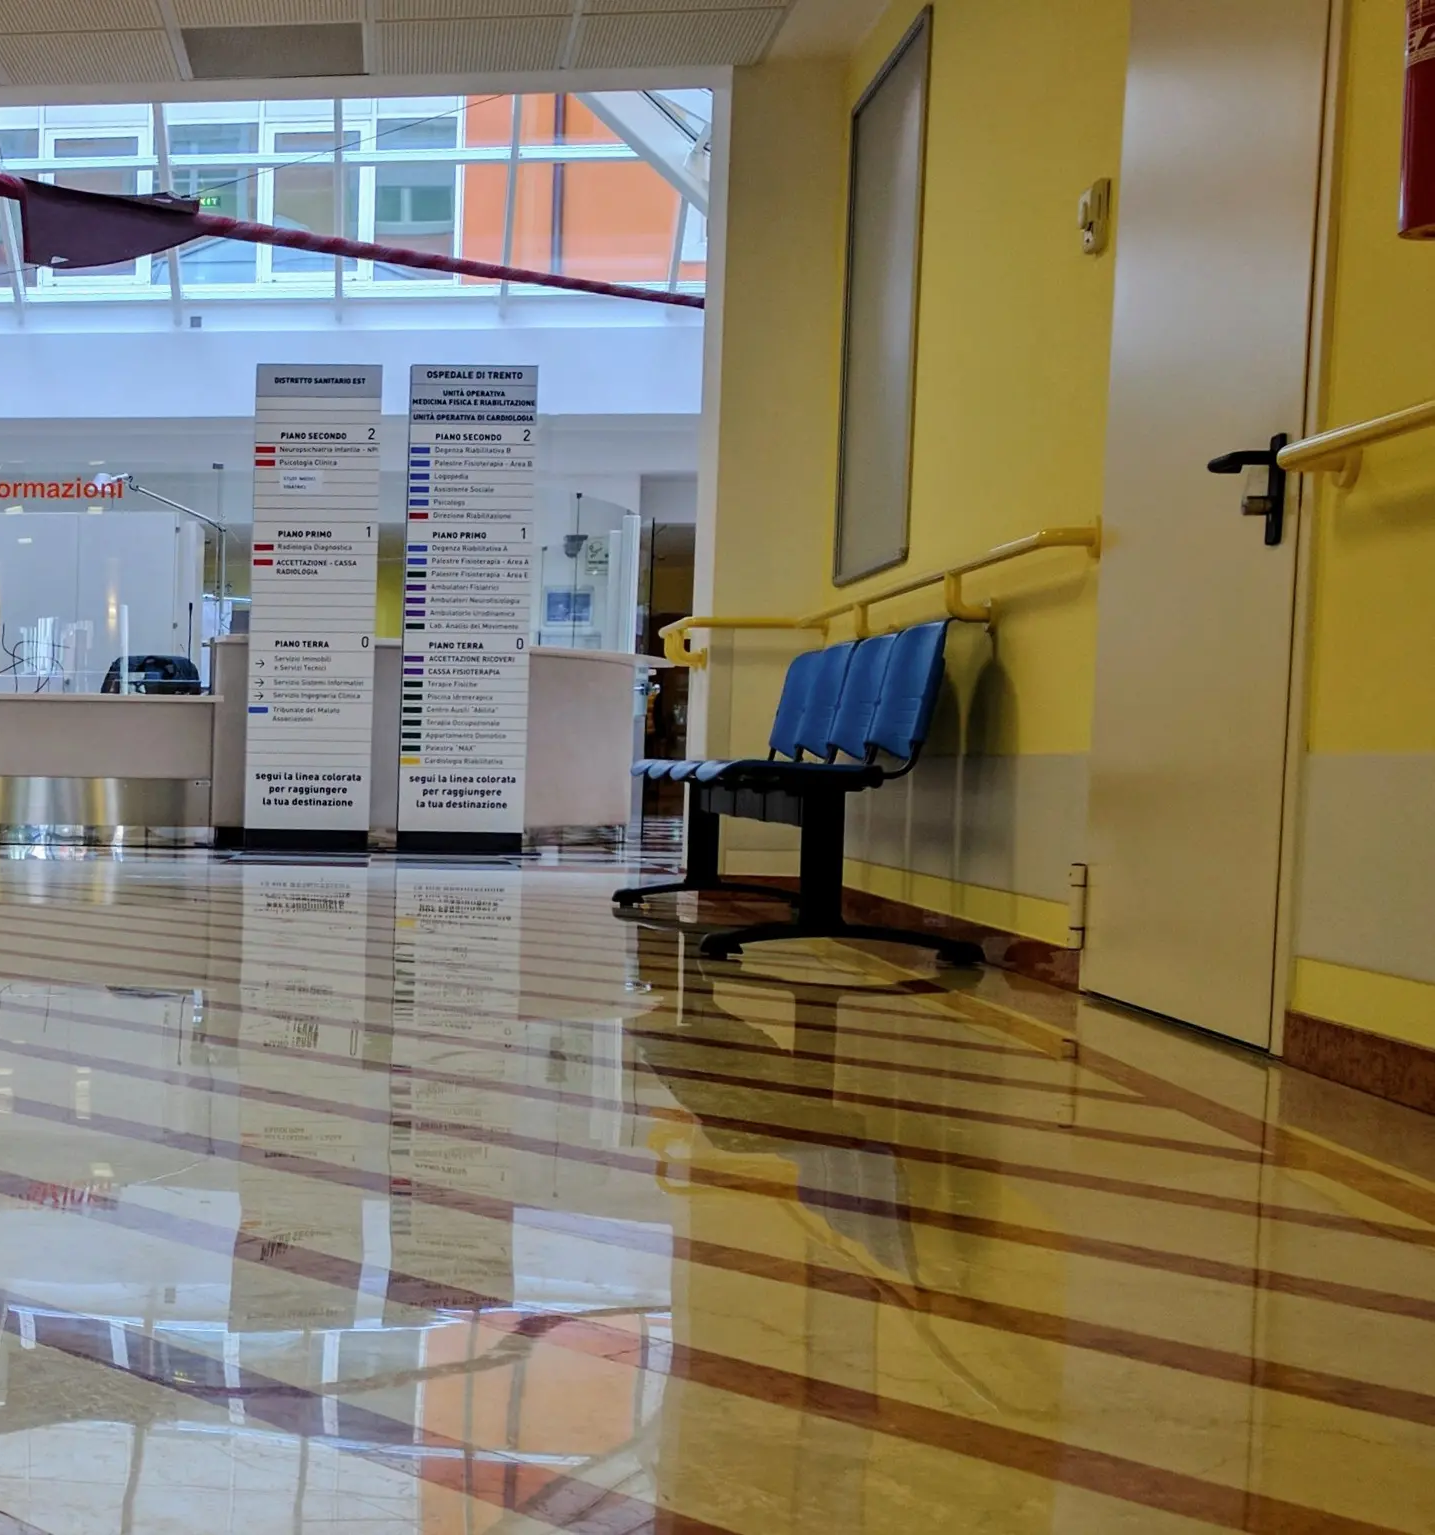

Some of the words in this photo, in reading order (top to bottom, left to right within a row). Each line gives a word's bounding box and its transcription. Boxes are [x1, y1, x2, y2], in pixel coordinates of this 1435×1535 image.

[427, 371, 473, 379] OSPEDALE
[443, 388, 464, 396] UNITÀ
[413, 412, 434, 420] UNITÀ
[281, 432, 306, 440] PIANO
[368, 428, 375, 440] 2
[523, 429, 530, 441] 2
[366, 526, 371, 538] 1
[521, 528, 526, 539] 1
[362, 636, 369, 648] 0
[516, 638, 523, 649] 0
[452, 720, 500, 728] Occupazionale
[256, 772, 282, 782] segui
[284, 772, 292, 780] la
[296, 773, 319, 781] linea
[409, 774, 436, 784] segui
[476, 775, 516, 783] colorata
[269, 786, 285, 794] per
[288, 785, 347, 795] raggiungere
[423, 788, 439, 796] per
[442, 788, 502, 797] raggiungere
[292, 798, 353, 806] destinazione
[416, 800, 425, 808] la
[446, 801, 507, 809] destinazione
